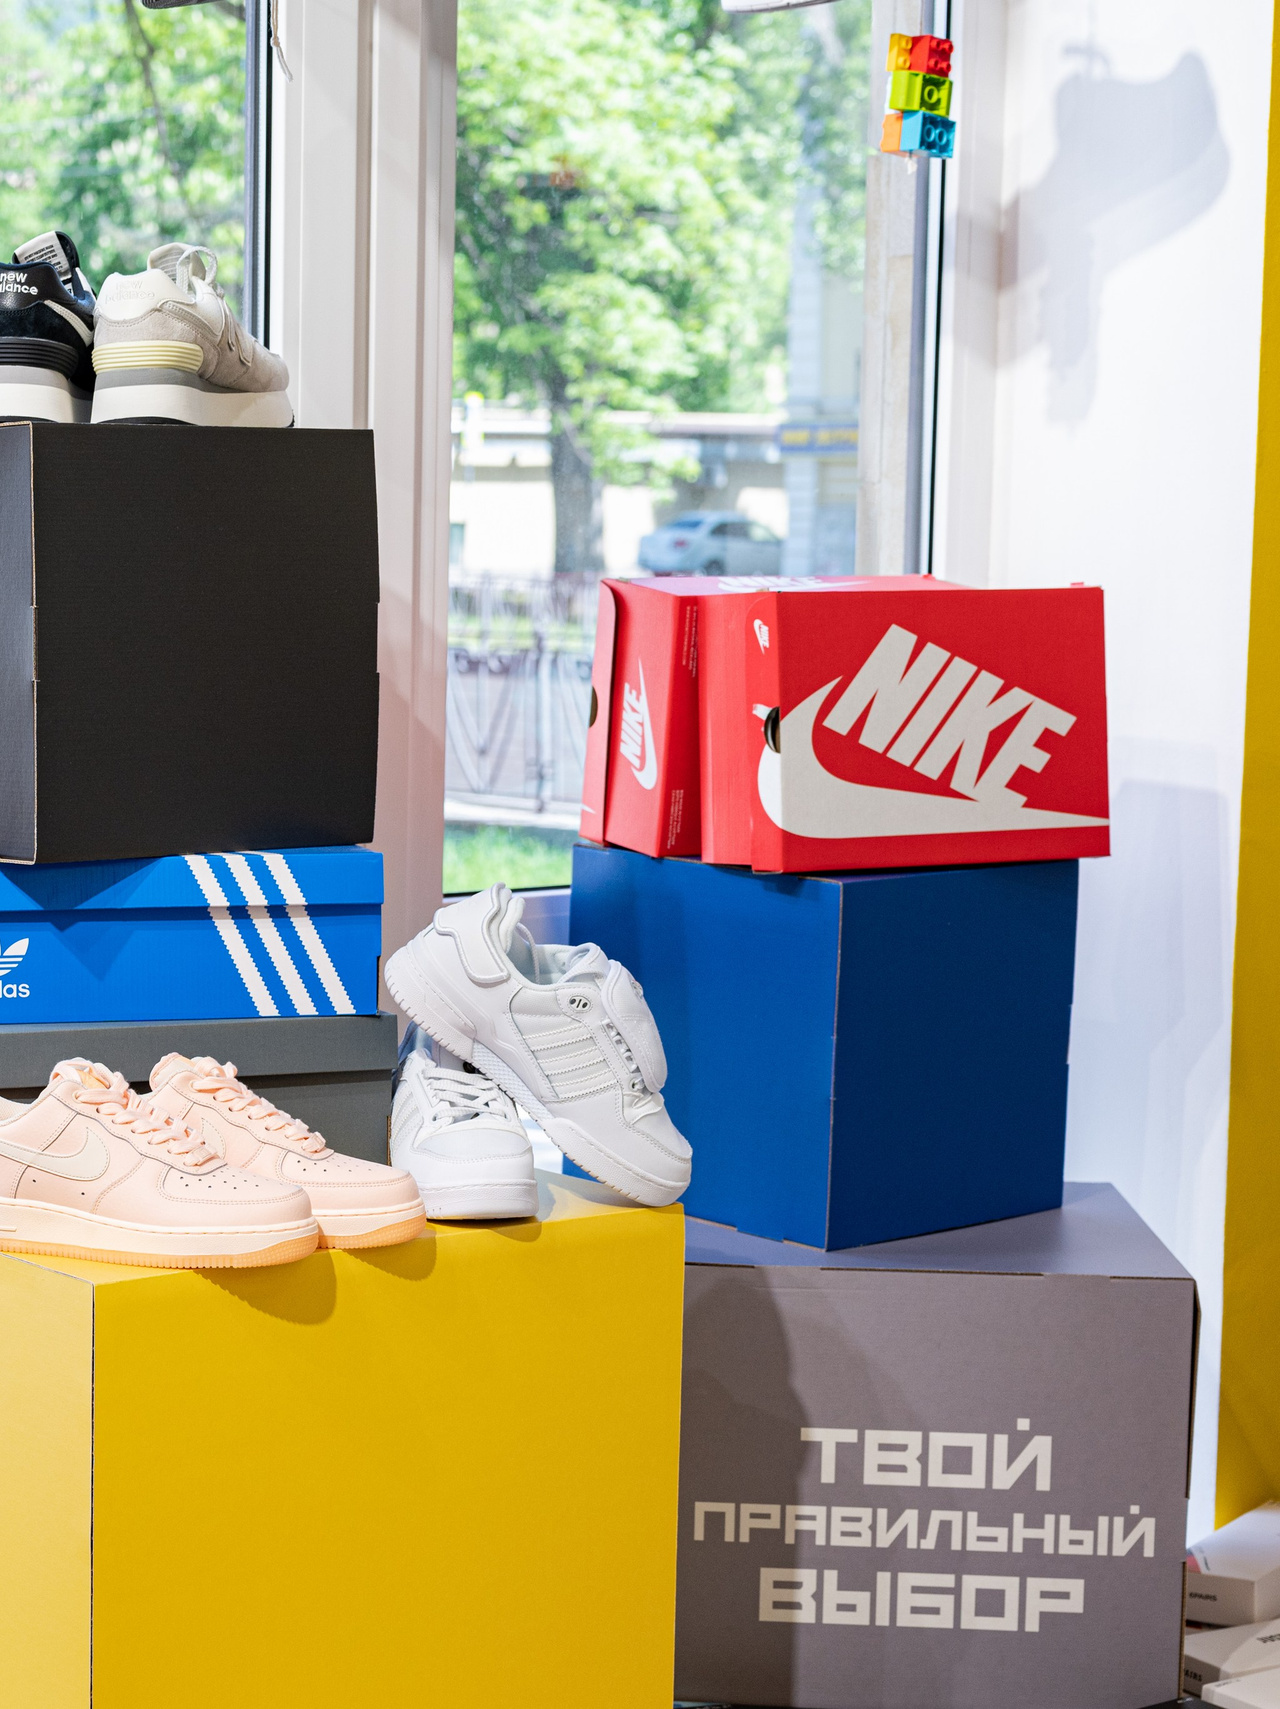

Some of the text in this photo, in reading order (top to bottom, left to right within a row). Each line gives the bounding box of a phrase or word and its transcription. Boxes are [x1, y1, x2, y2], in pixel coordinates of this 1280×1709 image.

[0, 271, 28, 283] new
[619, 682, 643, 770] NIKE
[822, 623, 1077, 808] NIKE
[800, 1418, 1053, 1492] ТВОЙ
[693, 1501, 1156, 1558] ПРАВИЛЬНЫЙ
[758, 1567, 1085, 1633] ВЫБОР
